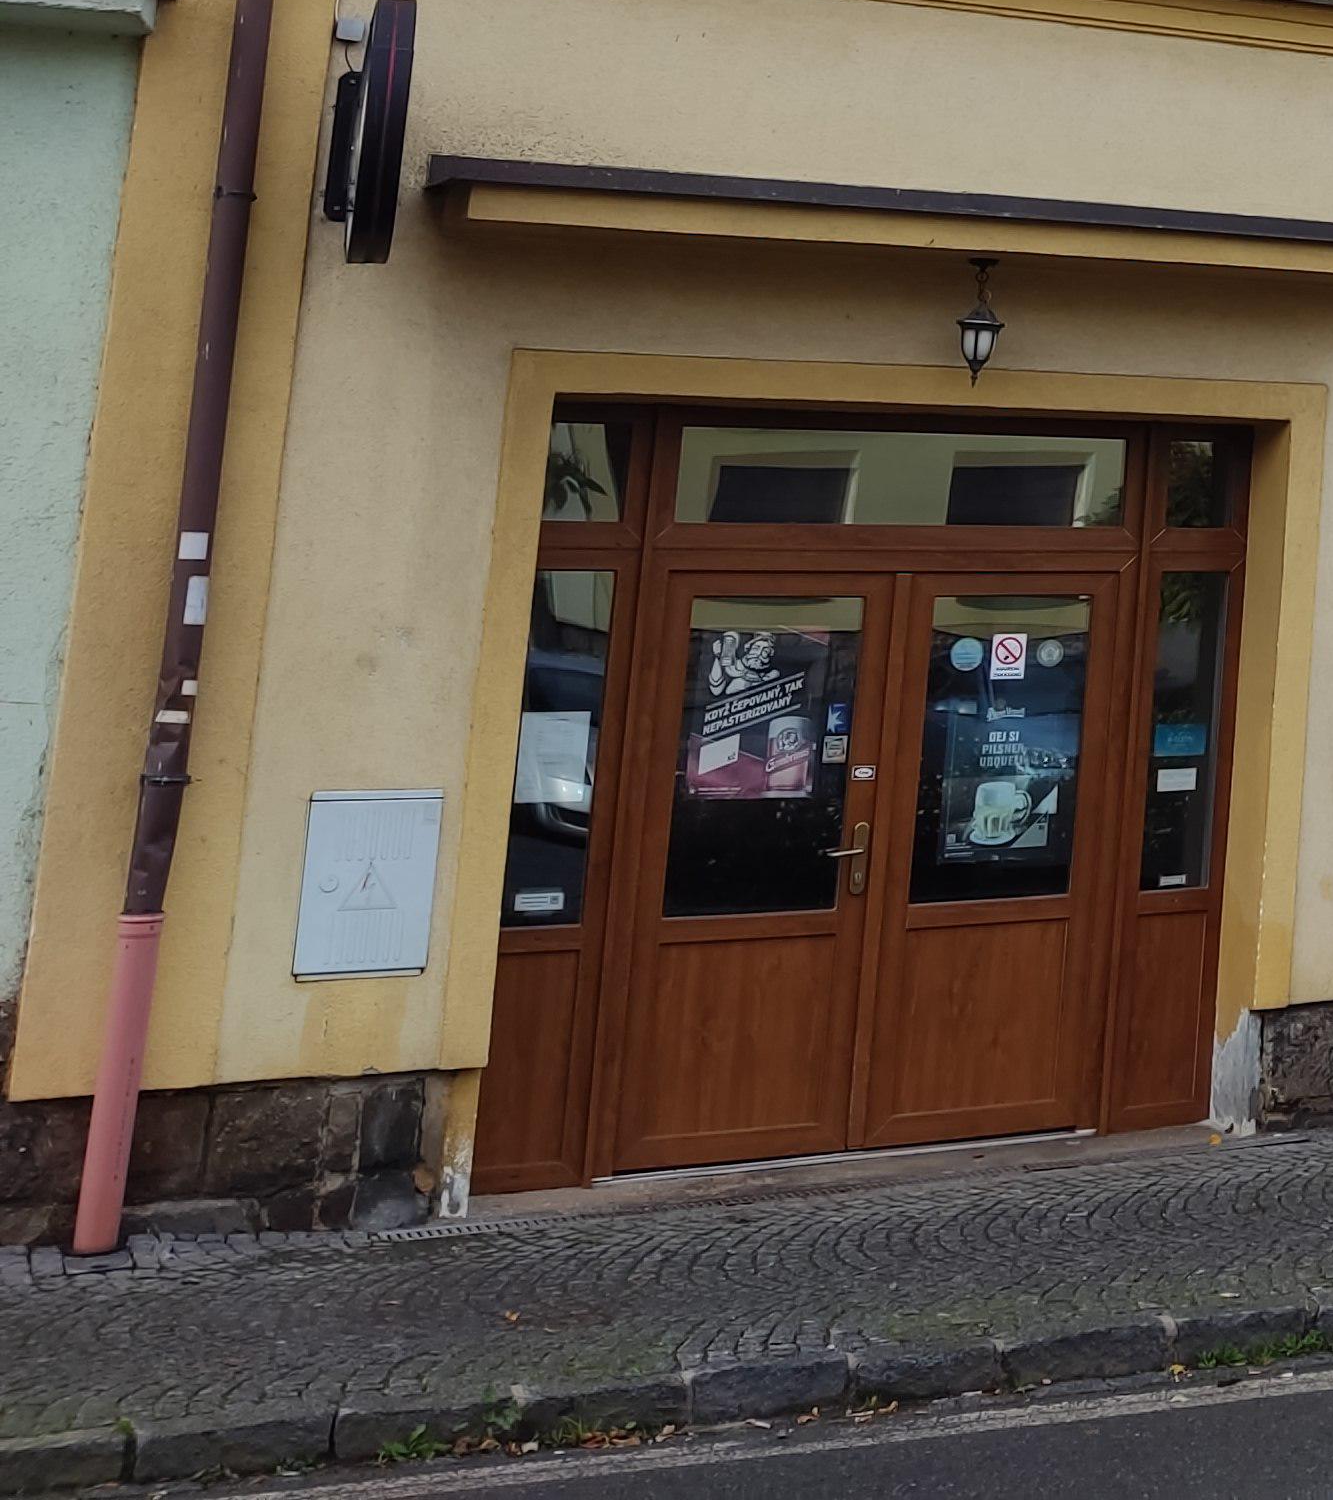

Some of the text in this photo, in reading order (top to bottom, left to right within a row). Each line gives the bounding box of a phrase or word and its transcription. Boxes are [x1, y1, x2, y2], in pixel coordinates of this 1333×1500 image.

[702, 694, 793, 736] NEPASTERIZOVANÝ
[704, 703, 732, 723] KDYŽ
[784, 677, 805, 693] TAK
[988, 731, 1020, 743] DEJ SI
